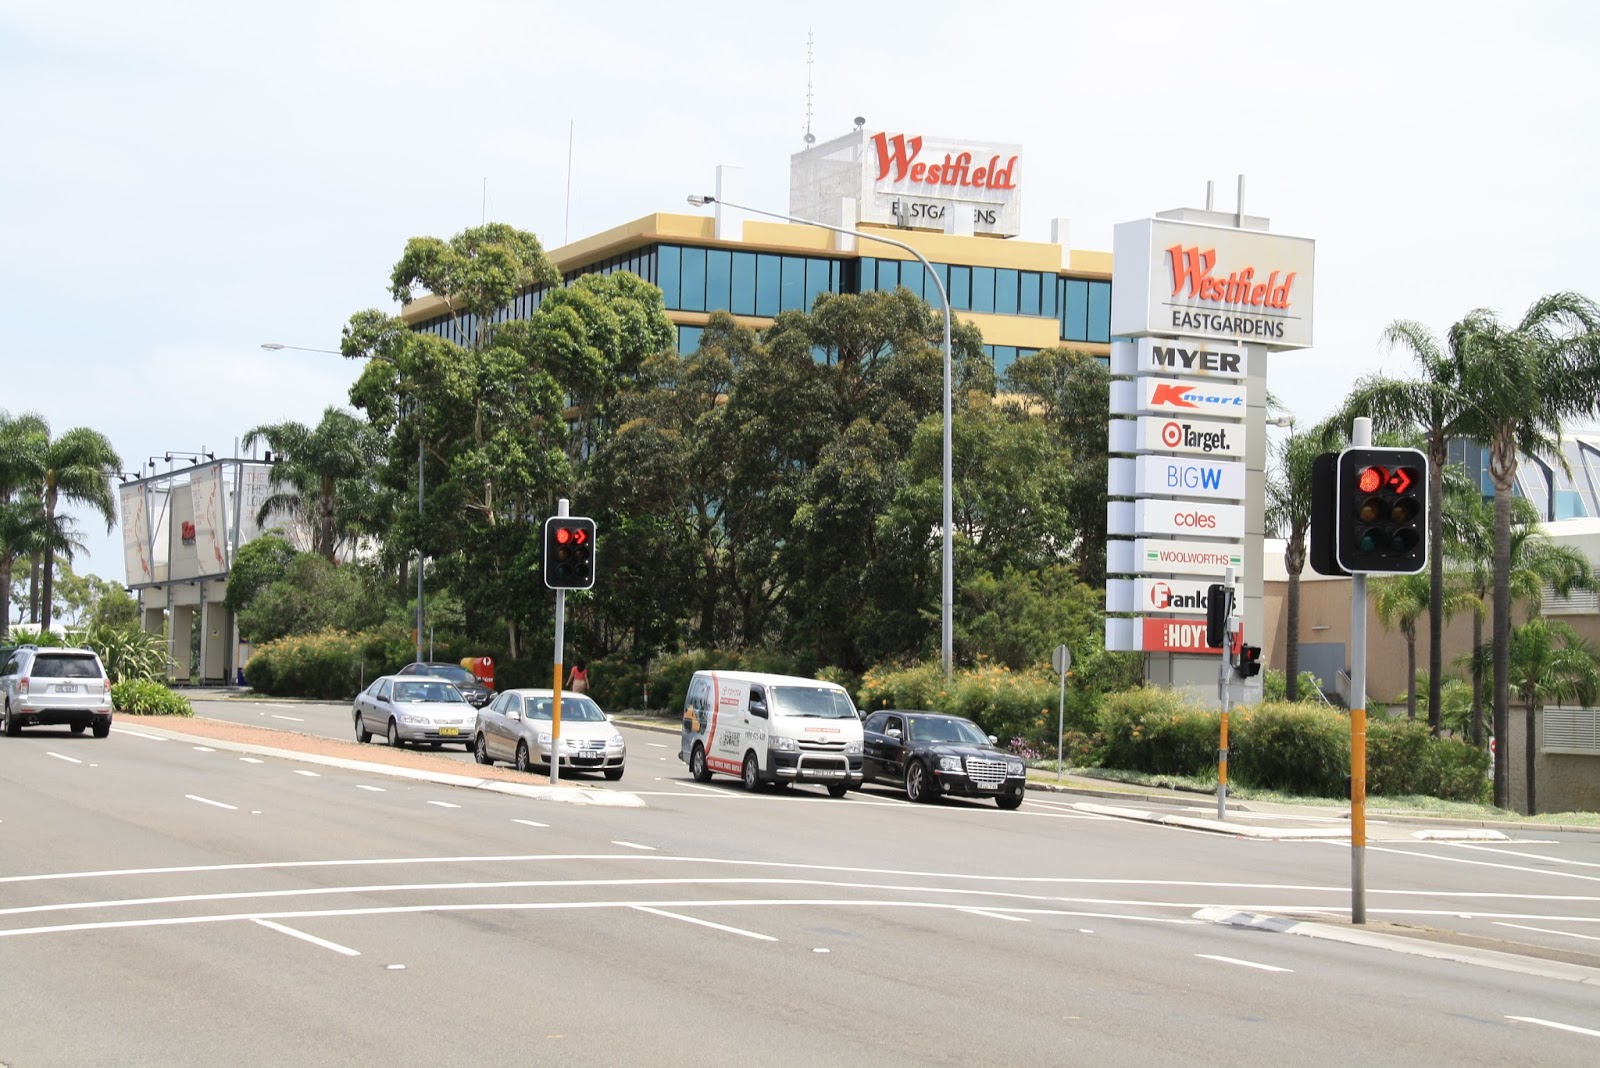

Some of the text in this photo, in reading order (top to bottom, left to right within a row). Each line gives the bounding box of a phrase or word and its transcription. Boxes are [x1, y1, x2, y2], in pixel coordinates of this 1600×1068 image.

[870, 132, 1018, 190] Westfield
[1166, 244, 1297, 309] Westfield
[1172, 310, 1284, 338] EASTGARDENS
[1152, 346, 1241, 373] MYER
[1151, 383, 1243, 408] Kmart
[1174, 511, 1216, 529] coles
[1160, 551, 1229, 566] WOOLWORTHS
[1168, 624, 1210, 648] HOYT
